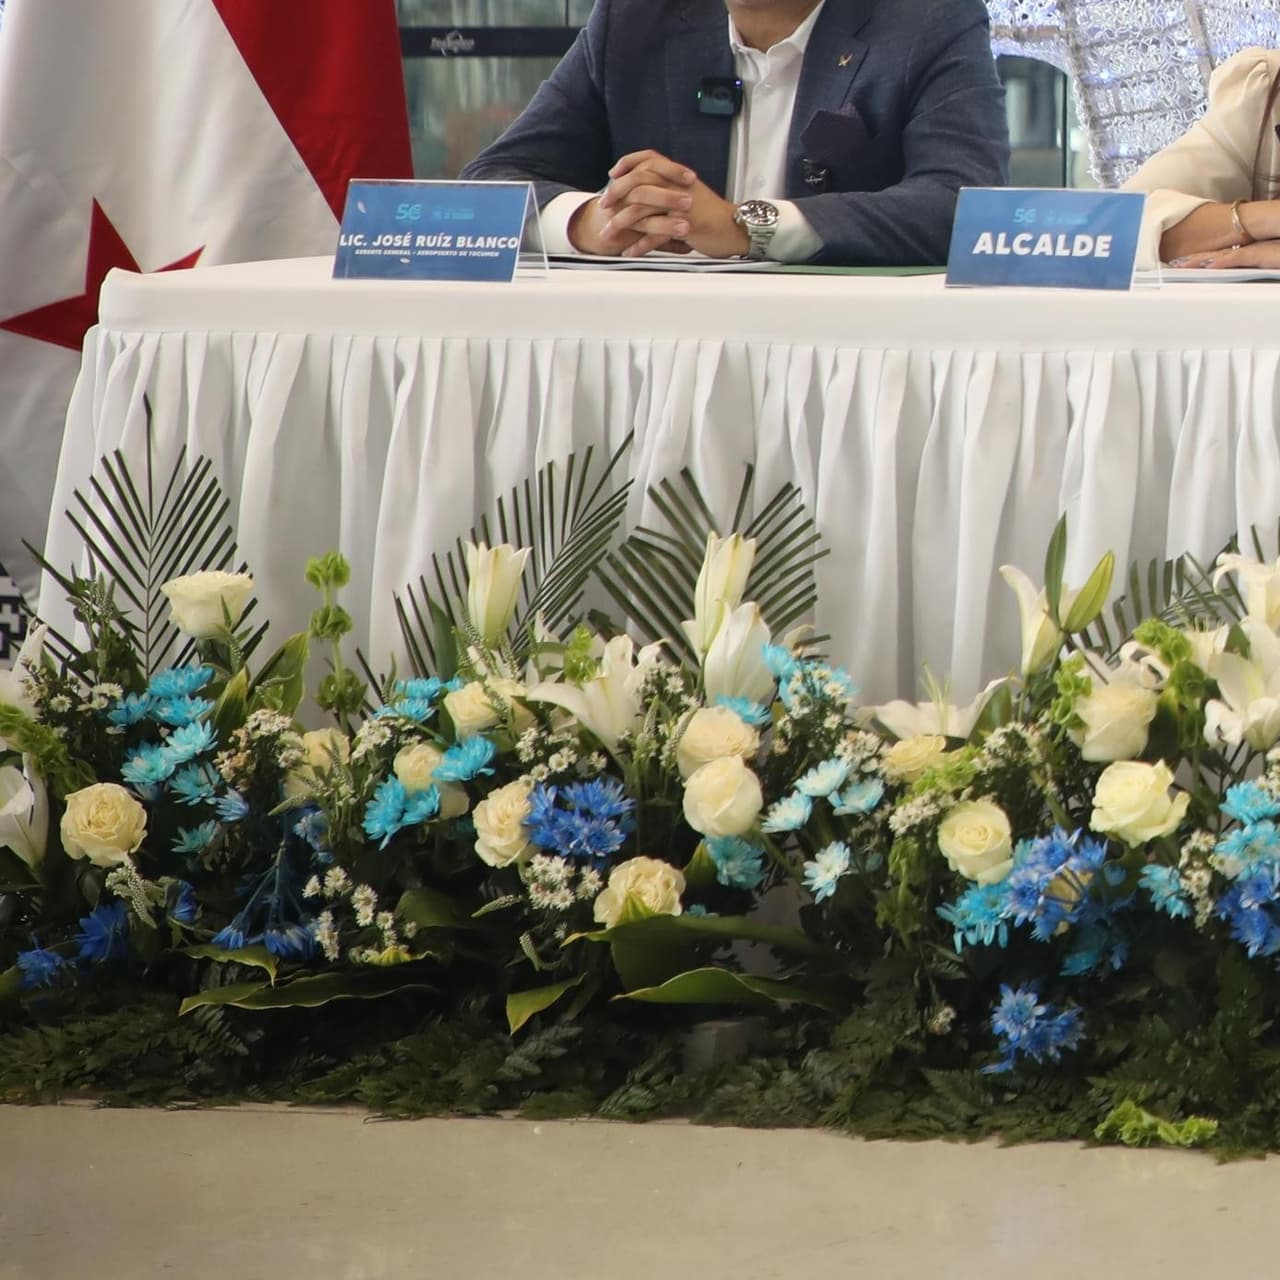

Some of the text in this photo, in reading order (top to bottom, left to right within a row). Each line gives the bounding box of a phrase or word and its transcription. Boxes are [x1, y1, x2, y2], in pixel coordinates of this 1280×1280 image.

[339, 231, 519, 249] LIC. JOSÉ RUÍZ BLANCO
[972, 232, 1113, 258] ALCALDE
